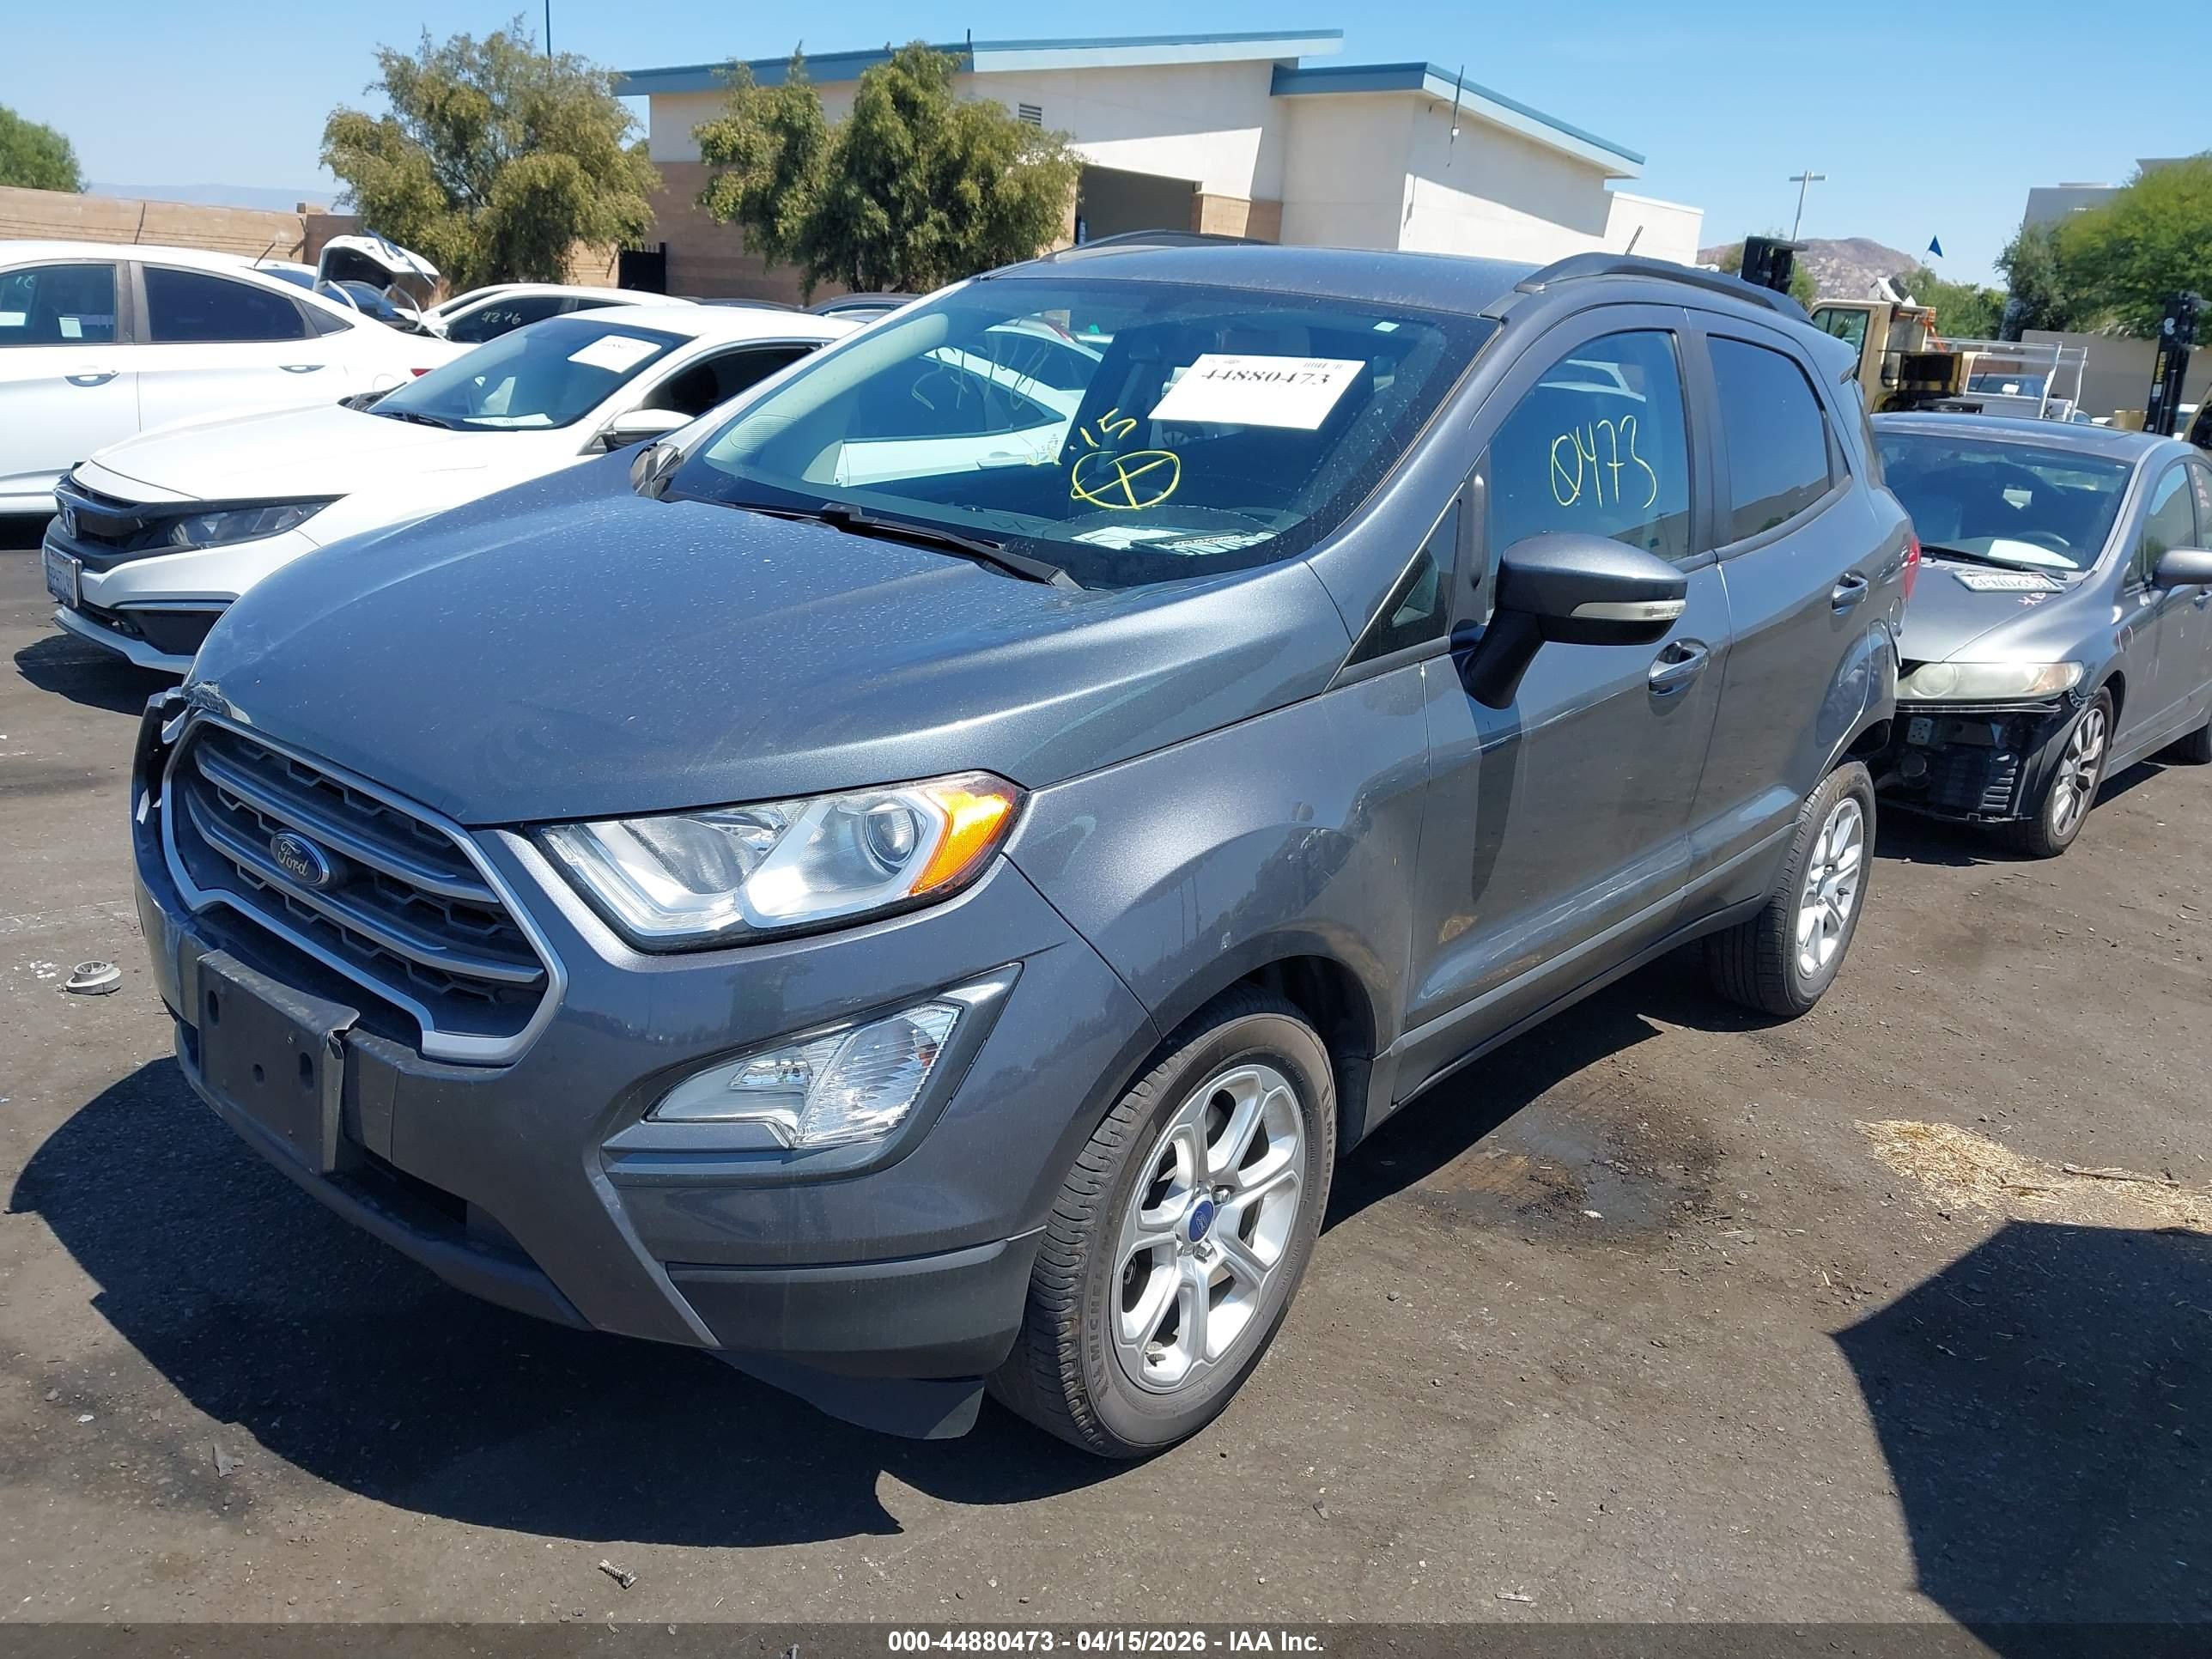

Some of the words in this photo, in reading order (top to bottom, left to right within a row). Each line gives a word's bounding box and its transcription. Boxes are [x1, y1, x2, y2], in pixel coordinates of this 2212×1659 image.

[1200, 368, 1331, 386] 44880473
[1550, 415, 1657, 509] 0473
[277, 840, 310, 877] Ford
